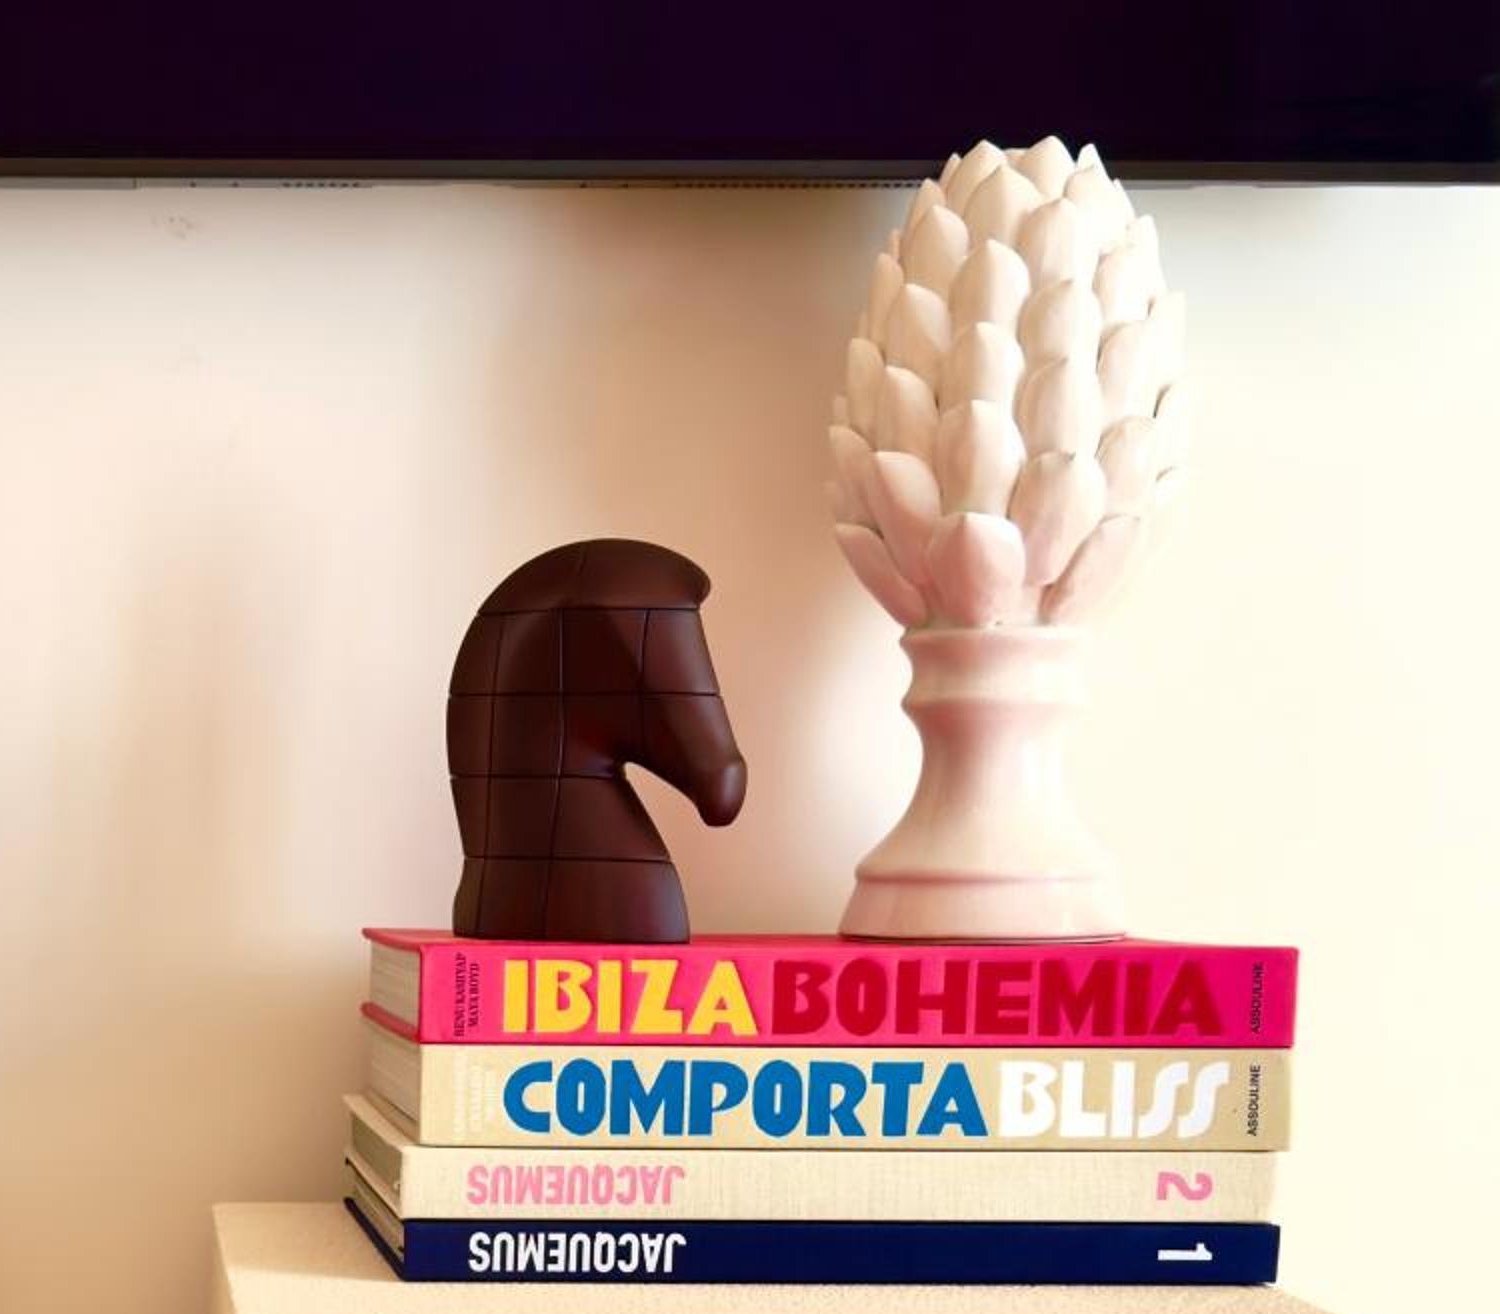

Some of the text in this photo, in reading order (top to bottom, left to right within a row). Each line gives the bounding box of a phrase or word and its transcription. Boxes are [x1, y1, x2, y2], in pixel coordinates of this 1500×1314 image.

[502, 959, 1223, 1037] IBIZA BOHEMIA
[1250, 961, 1264, 1034] ASSOULINE
[503, 1060, 989, 1138] COMPORTA
[998, 1060, 1231, 1138] BLISS
[1247, 1064, 1261, 1137] ASSOULINE
[467, 1165, 686, 1206] JACQUEMUS
[1156, 1171, 1213, 1201] 2
[468, 1231, 687, 1272] JACQUEMUS
[1157, 1243, 1213, 1262] 1
